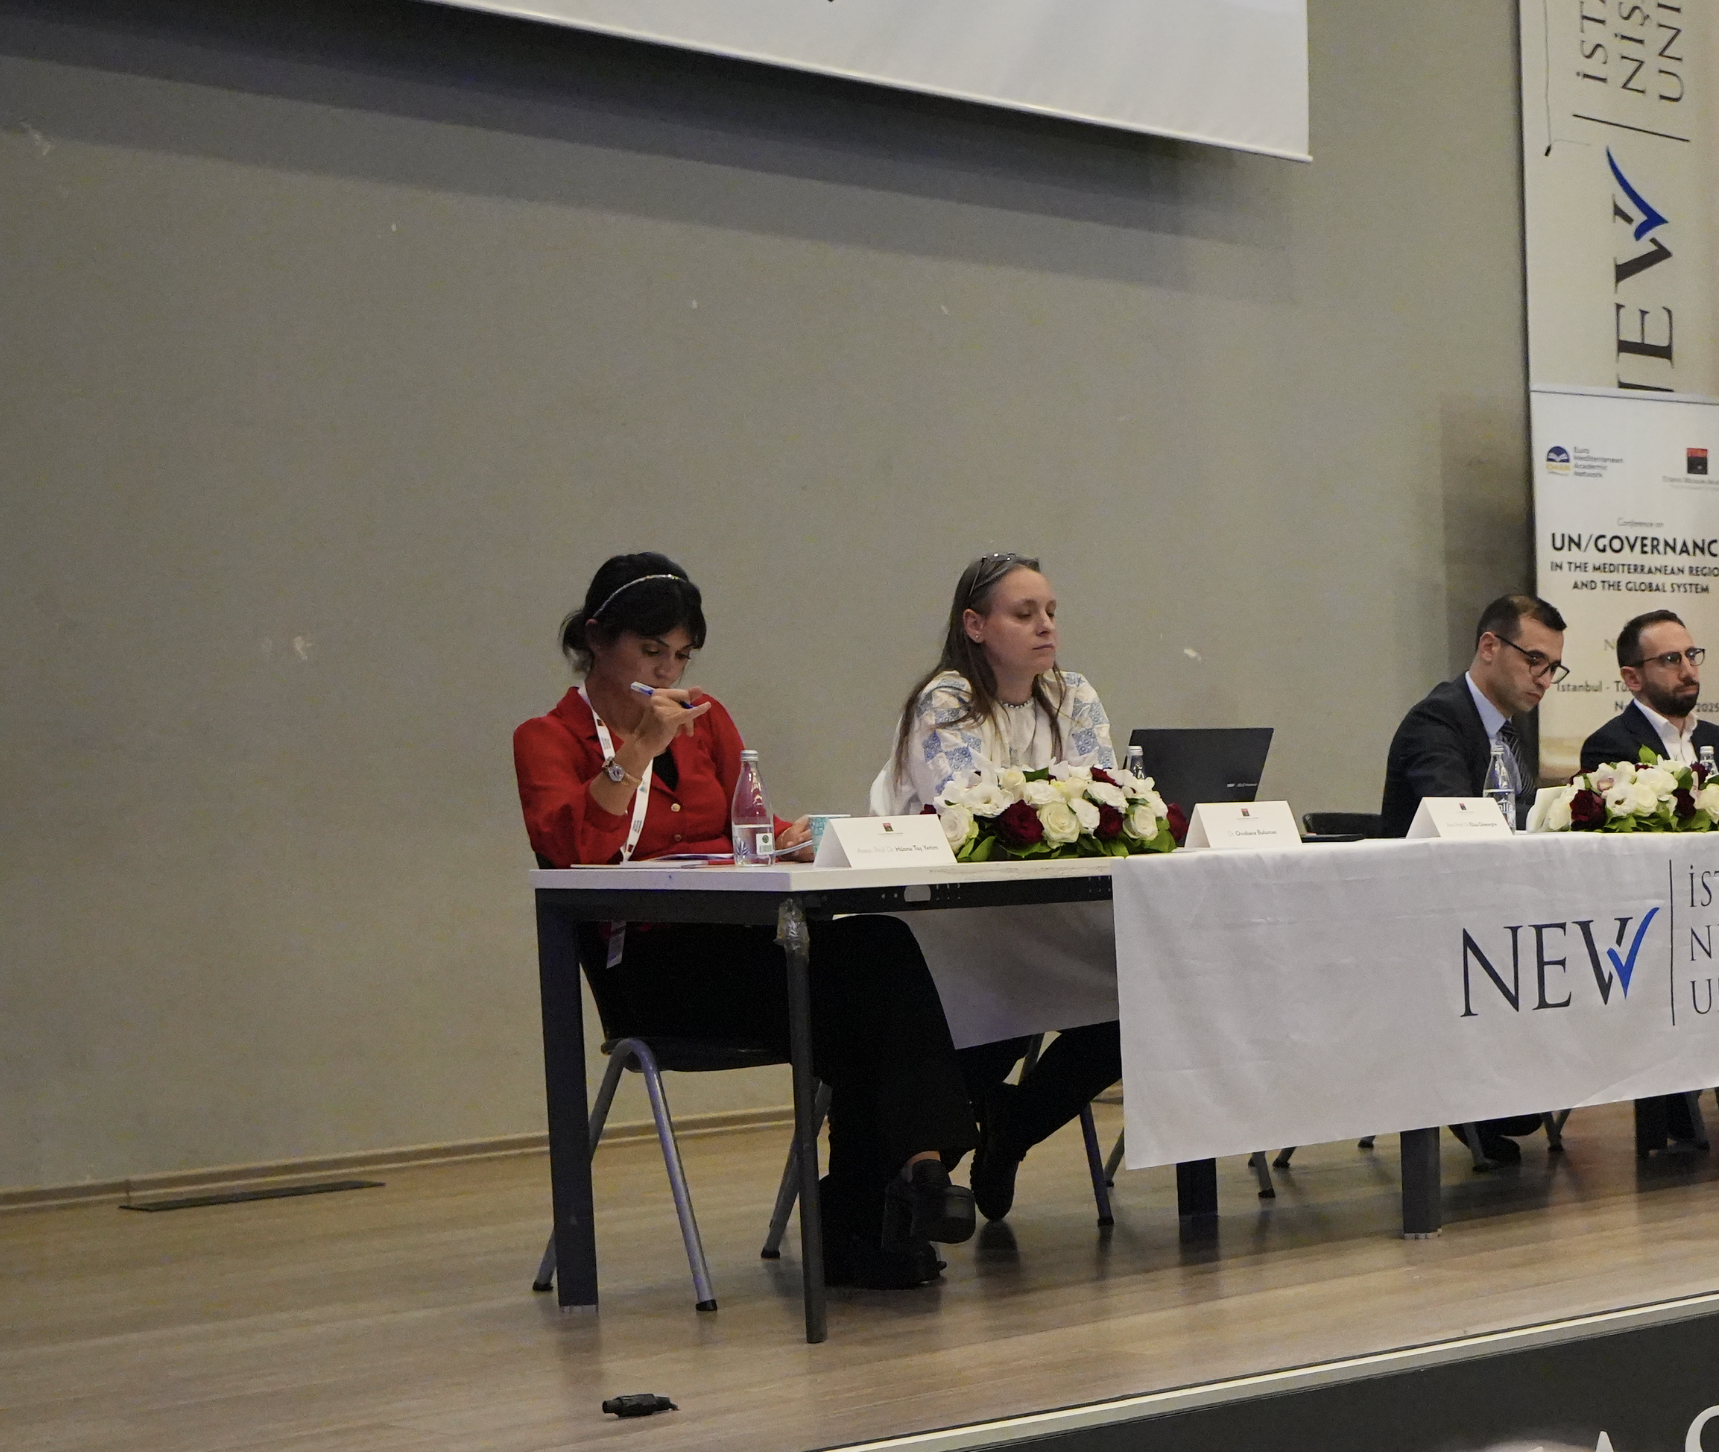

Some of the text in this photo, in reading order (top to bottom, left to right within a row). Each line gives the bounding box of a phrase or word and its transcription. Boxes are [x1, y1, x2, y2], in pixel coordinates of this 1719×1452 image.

[1576, 0, 1608, 83] İST
[1614, 0, 1649, 94] NİŞ
[1606, 146, 1674, 392] EW
[1551, 561, 1563, 572] IN
[1567, 561, 1588, 573] THE
[1592, 562, 1685, 576] MEDITERRANEAN
[1572, 579, 1710, 594] AND THE GLOBAL SYSTEM
[1460, 907, 1660, 1018] NEW
